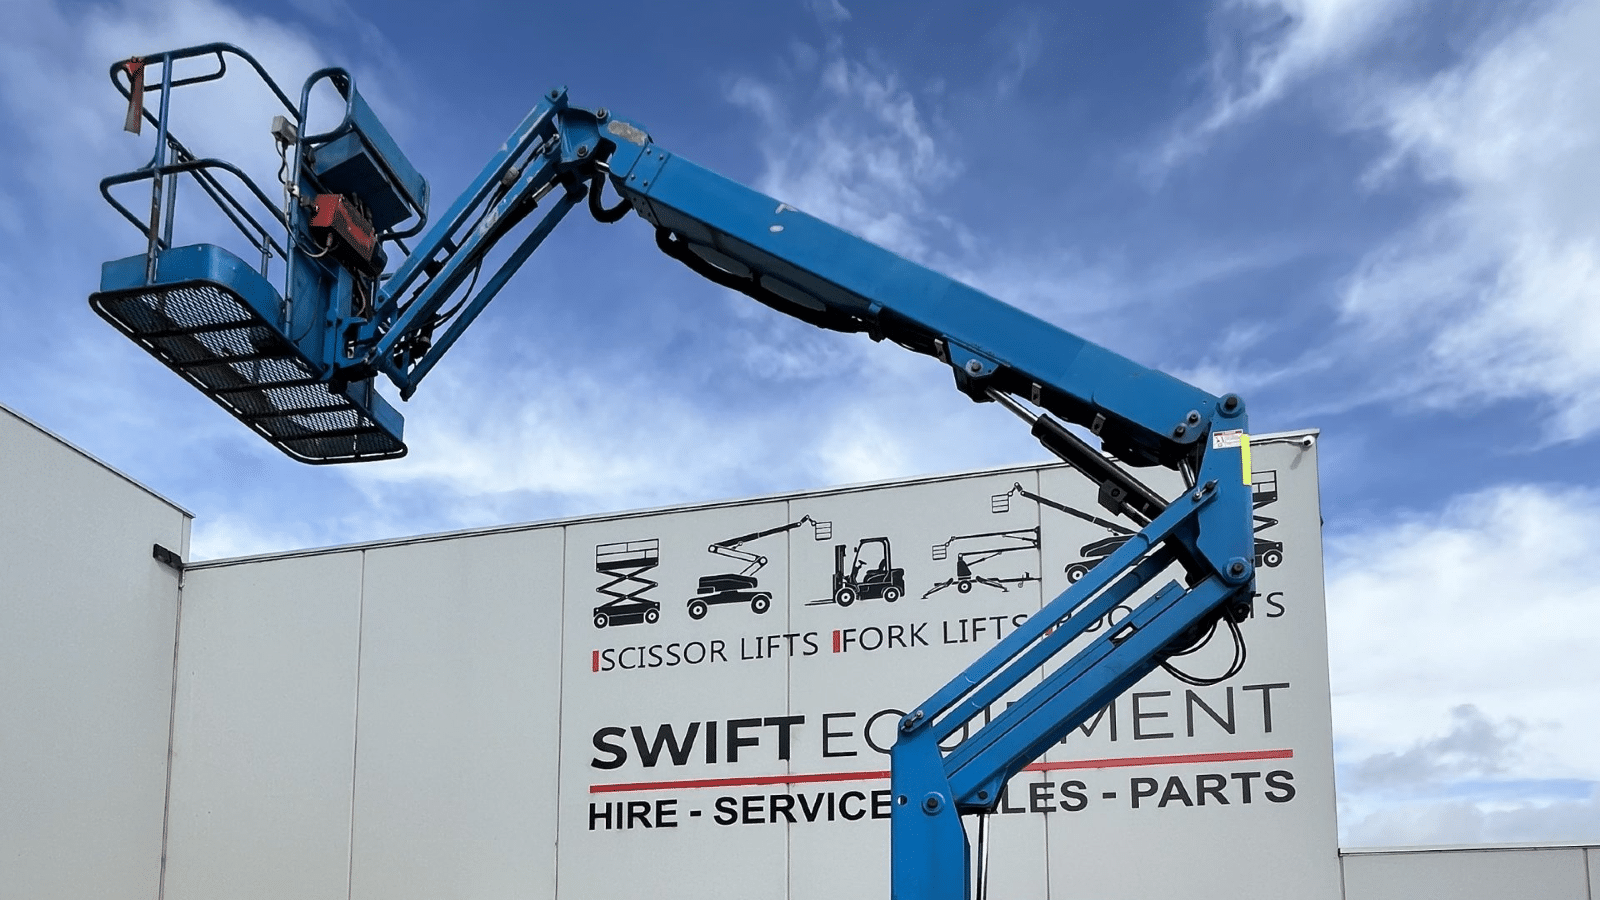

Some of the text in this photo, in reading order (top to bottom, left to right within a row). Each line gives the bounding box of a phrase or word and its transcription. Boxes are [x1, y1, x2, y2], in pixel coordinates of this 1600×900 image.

[602, 641, 728, 672] SCISSOR
[742, 631, 819, 661] LIFTS
[842, 622, 929, 653] FORK
[591, 682, 1290, 770] SWIFT EMENT
[588, 799, 678, 831] HIRE
[713, 789, 892, 826] SERVICE
[992, 780, 1088, 814] LES
[1130, 770, 1296, 809] PARTS
